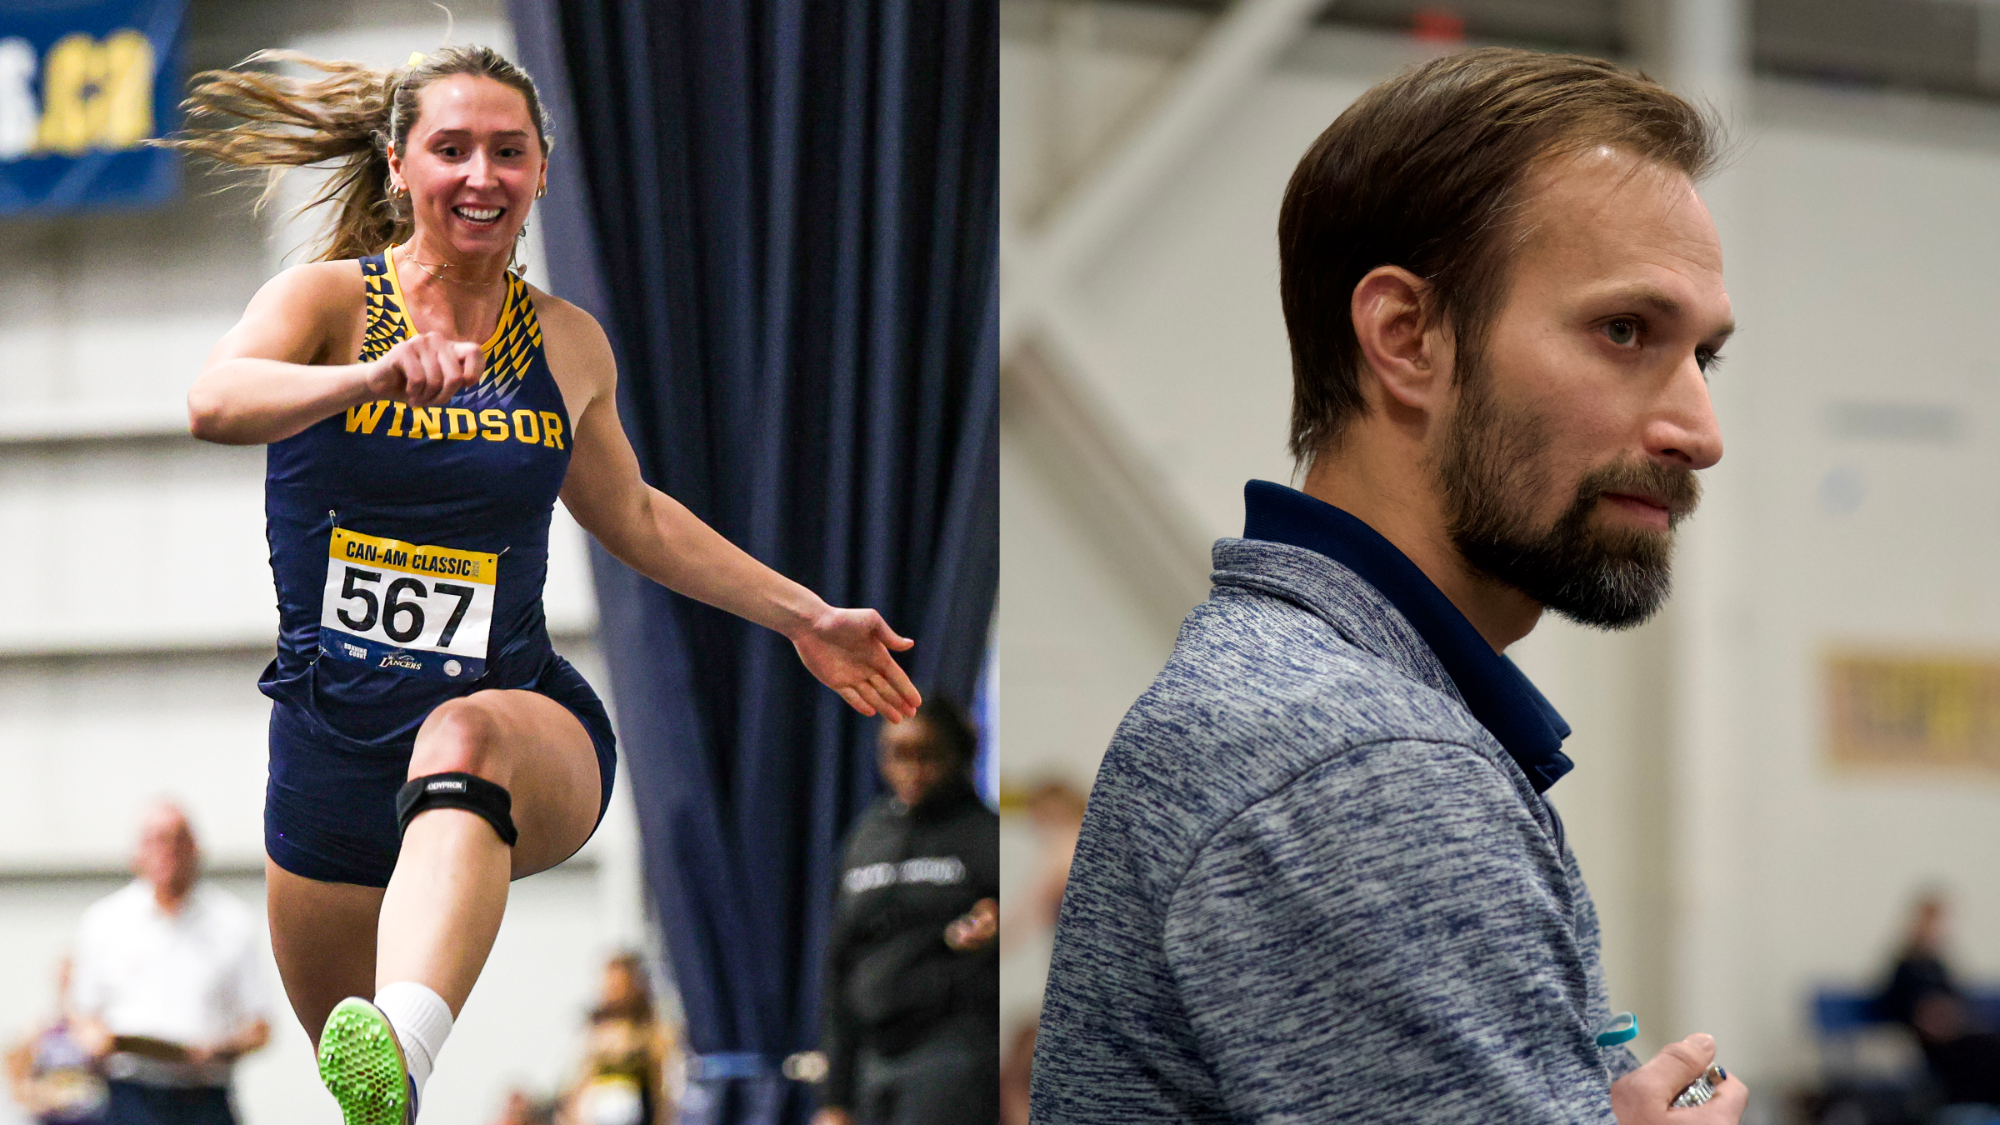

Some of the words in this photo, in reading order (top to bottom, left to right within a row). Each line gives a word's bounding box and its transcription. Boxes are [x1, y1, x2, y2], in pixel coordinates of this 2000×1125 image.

[345, 400, 565, 450] WINDSOR
[346, 541, 408, 567] CAN-AM
[412, 555, 472, 577] CLASSIC
[337, 566, 475, 648] 567
[379, 657, 422, 671] LANCERS
